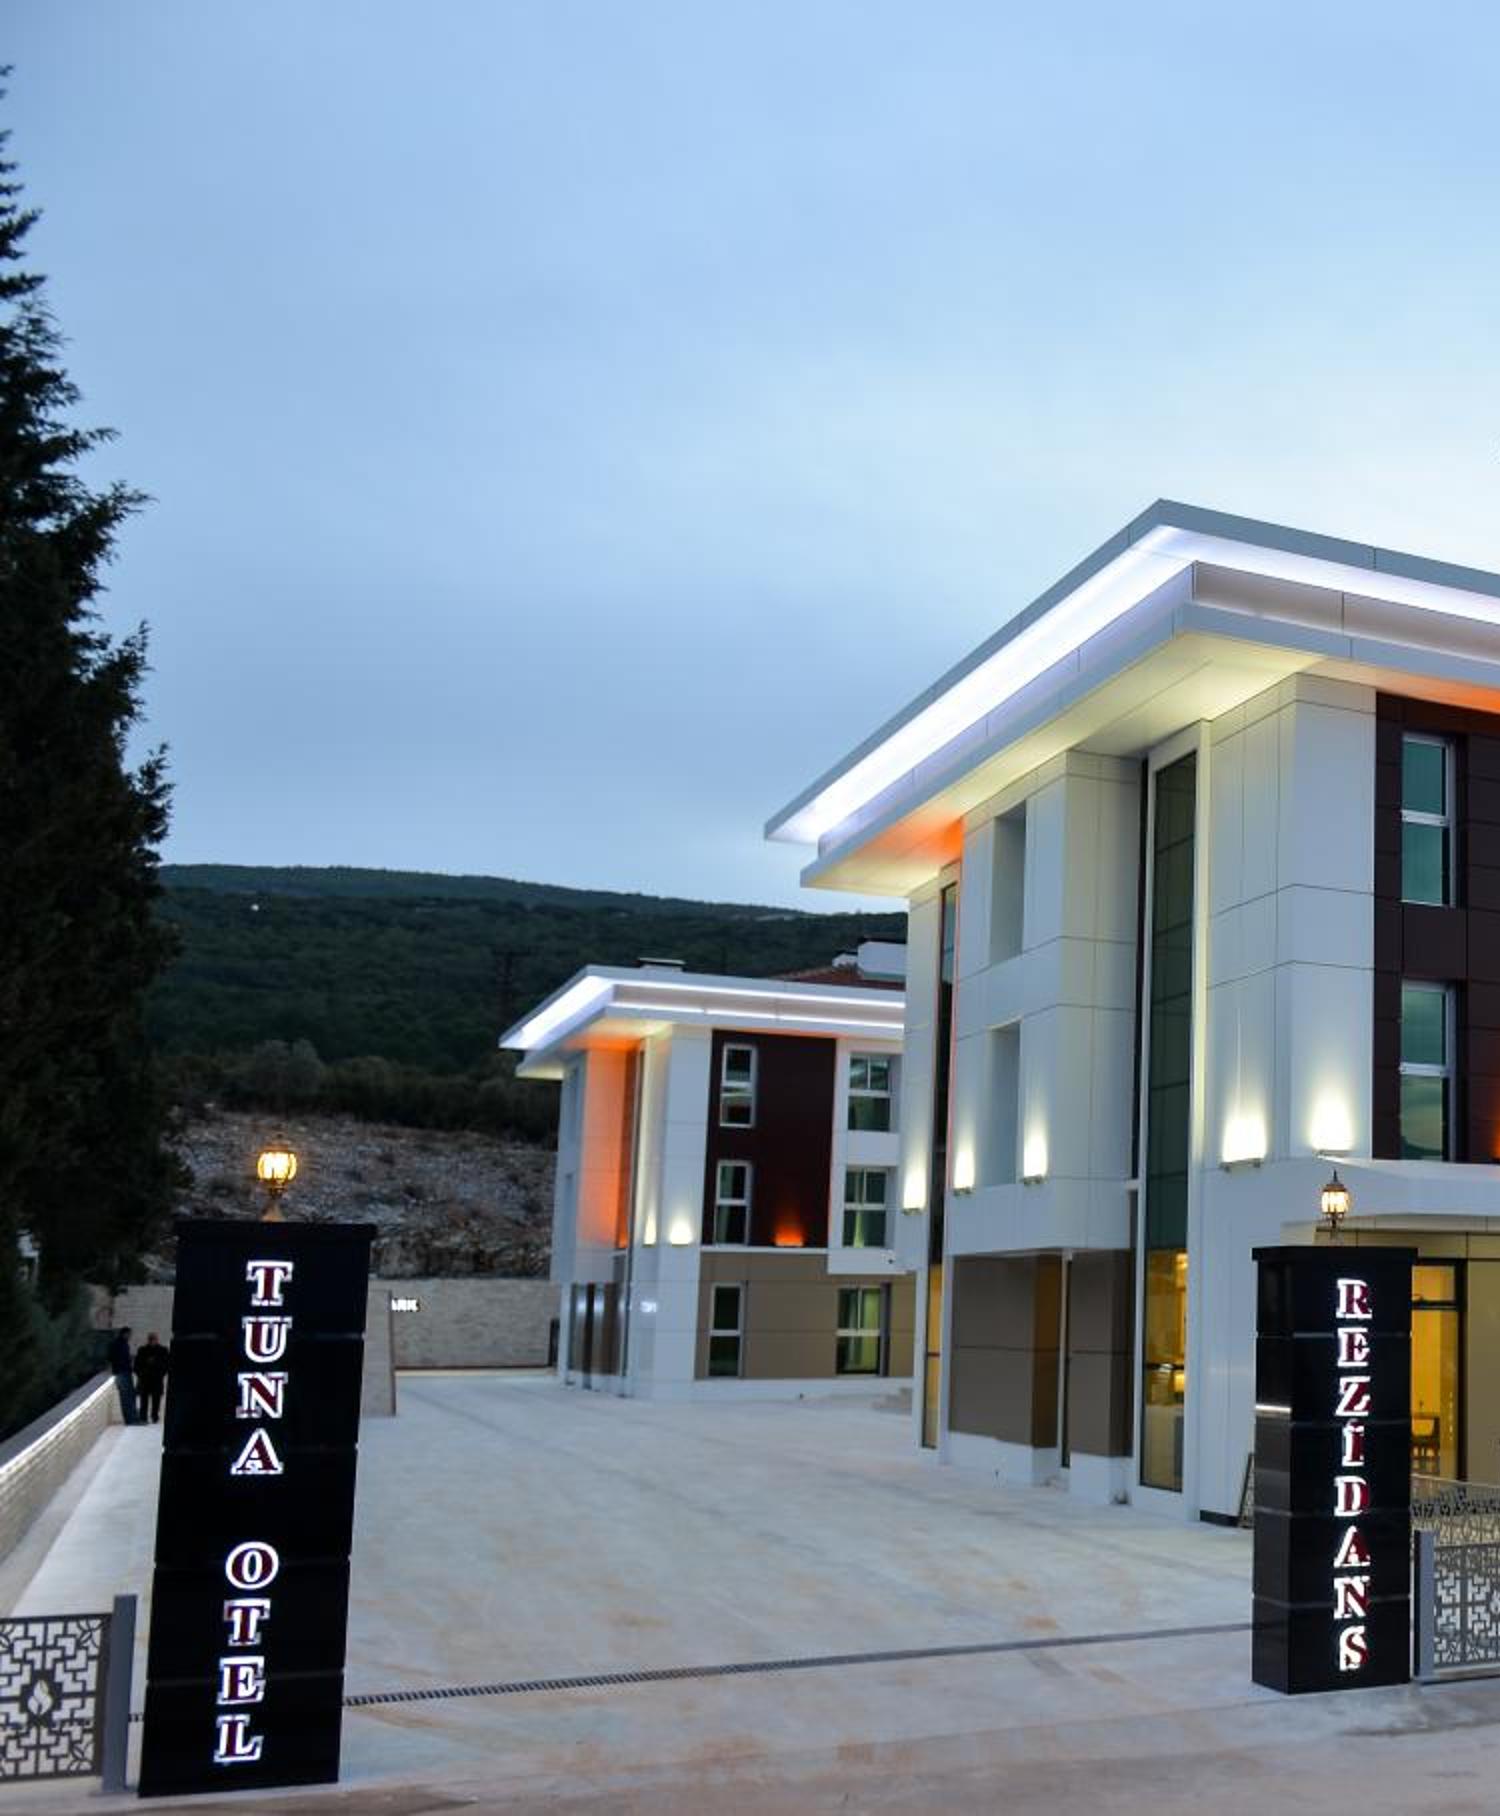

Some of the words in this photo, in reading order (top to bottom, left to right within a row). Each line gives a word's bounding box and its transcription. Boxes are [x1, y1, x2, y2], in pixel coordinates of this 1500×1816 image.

[231, 1260, 293, 1476] TUNA
[1333, 1278, 1373, 1672] REZİDANS
[213, 1541, 279, 1763] OTEL
